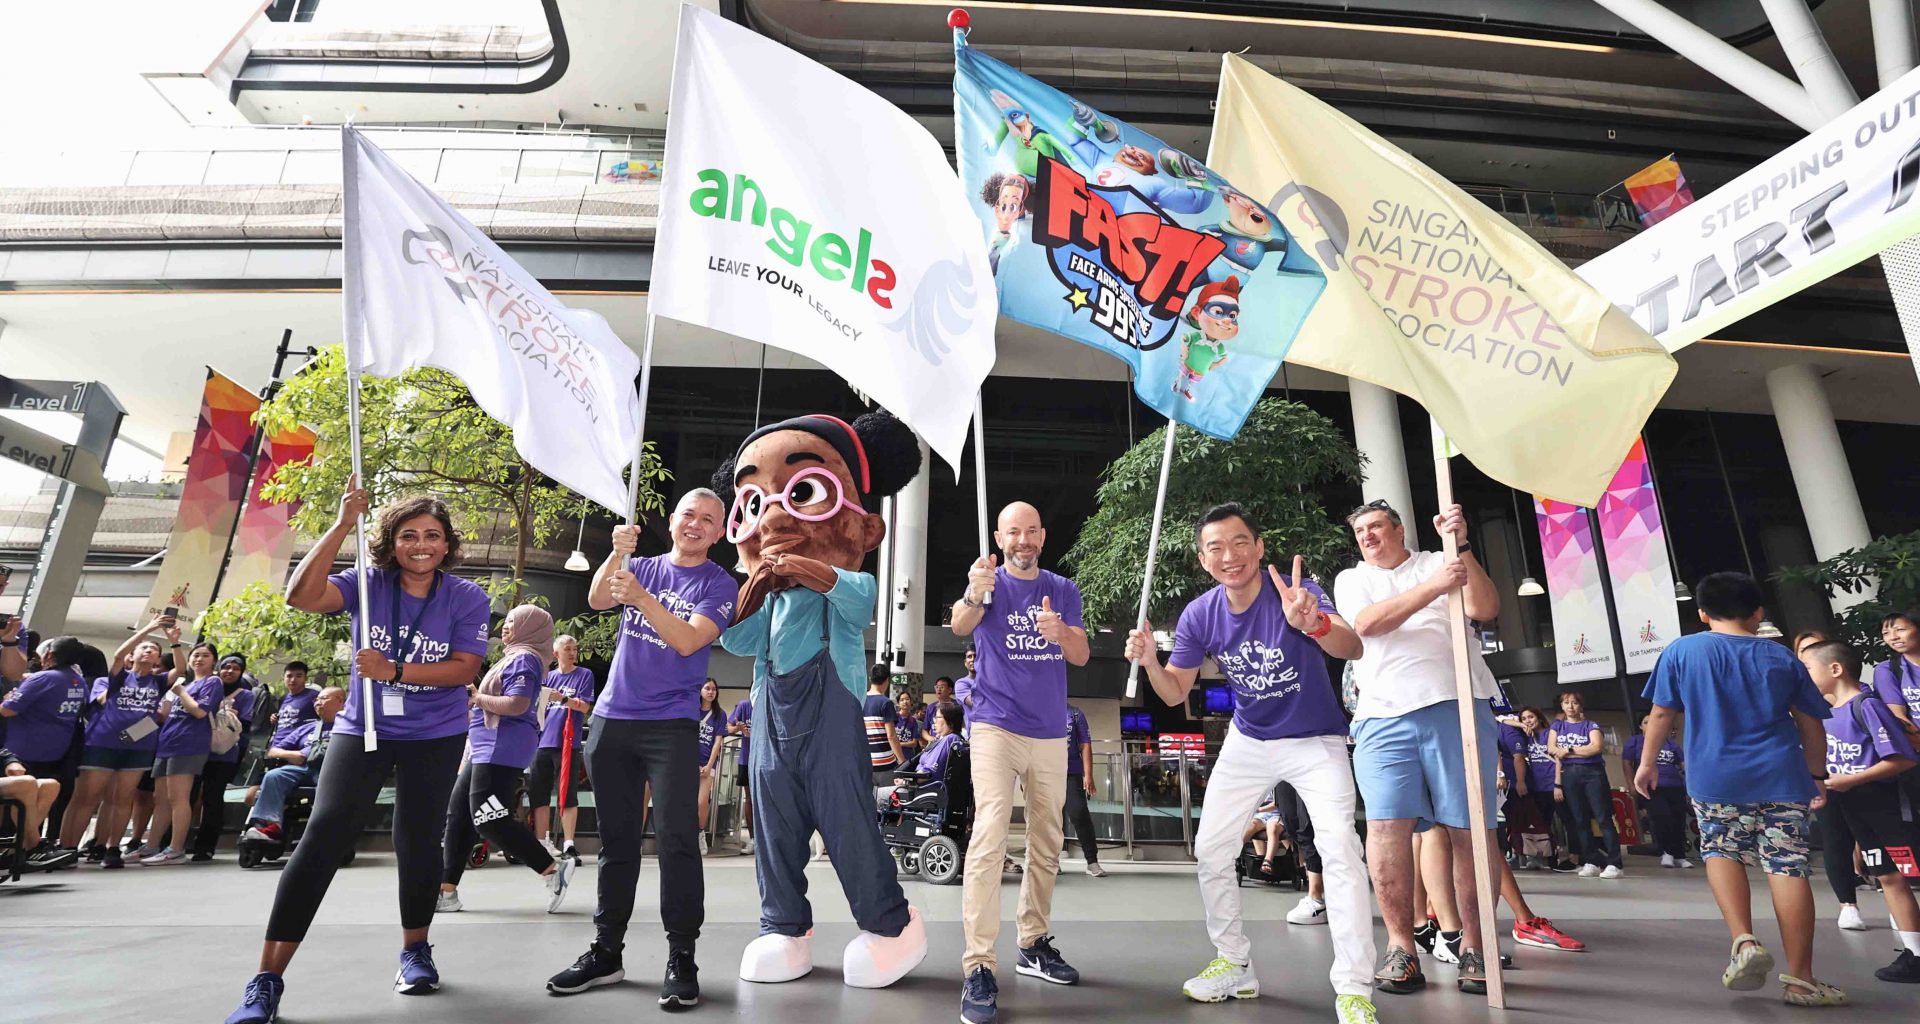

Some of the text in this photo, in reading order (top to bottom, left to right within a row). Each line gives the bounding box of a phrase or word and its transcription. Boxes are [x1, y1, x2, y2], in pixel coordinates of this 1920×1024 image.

[1700, 139, 1844, 239] STEPPING
[1854, 88, 1920, 149] OUT
[689, 168, 897, 309] angels
[1046, 157, 1227, 313] FAST!
[1368, 199, 1478, 248] SINGA
[1070, 254, 1097, 279] FACE
[1096, 267, 1119, 297] ARMS
[1357, 226, 1527, 293] NATIONA
[1617, 180, 1849, 338] TART
[708, 255, 863, 342] LEAVE YOUR LEGACY
[1350, 255, 1566, 350] STROKE
[9, 381, 88, 412] Level 1
[0, 435, 77, 479] Level 1
[372, 640, 392, 652] ou
[1005, 633, 1049, 650] STRO
[1013, 621, 1031, 632] out
[1629, 650, 1640, 658] OUR
[474, 808, 509, 826] adidas
